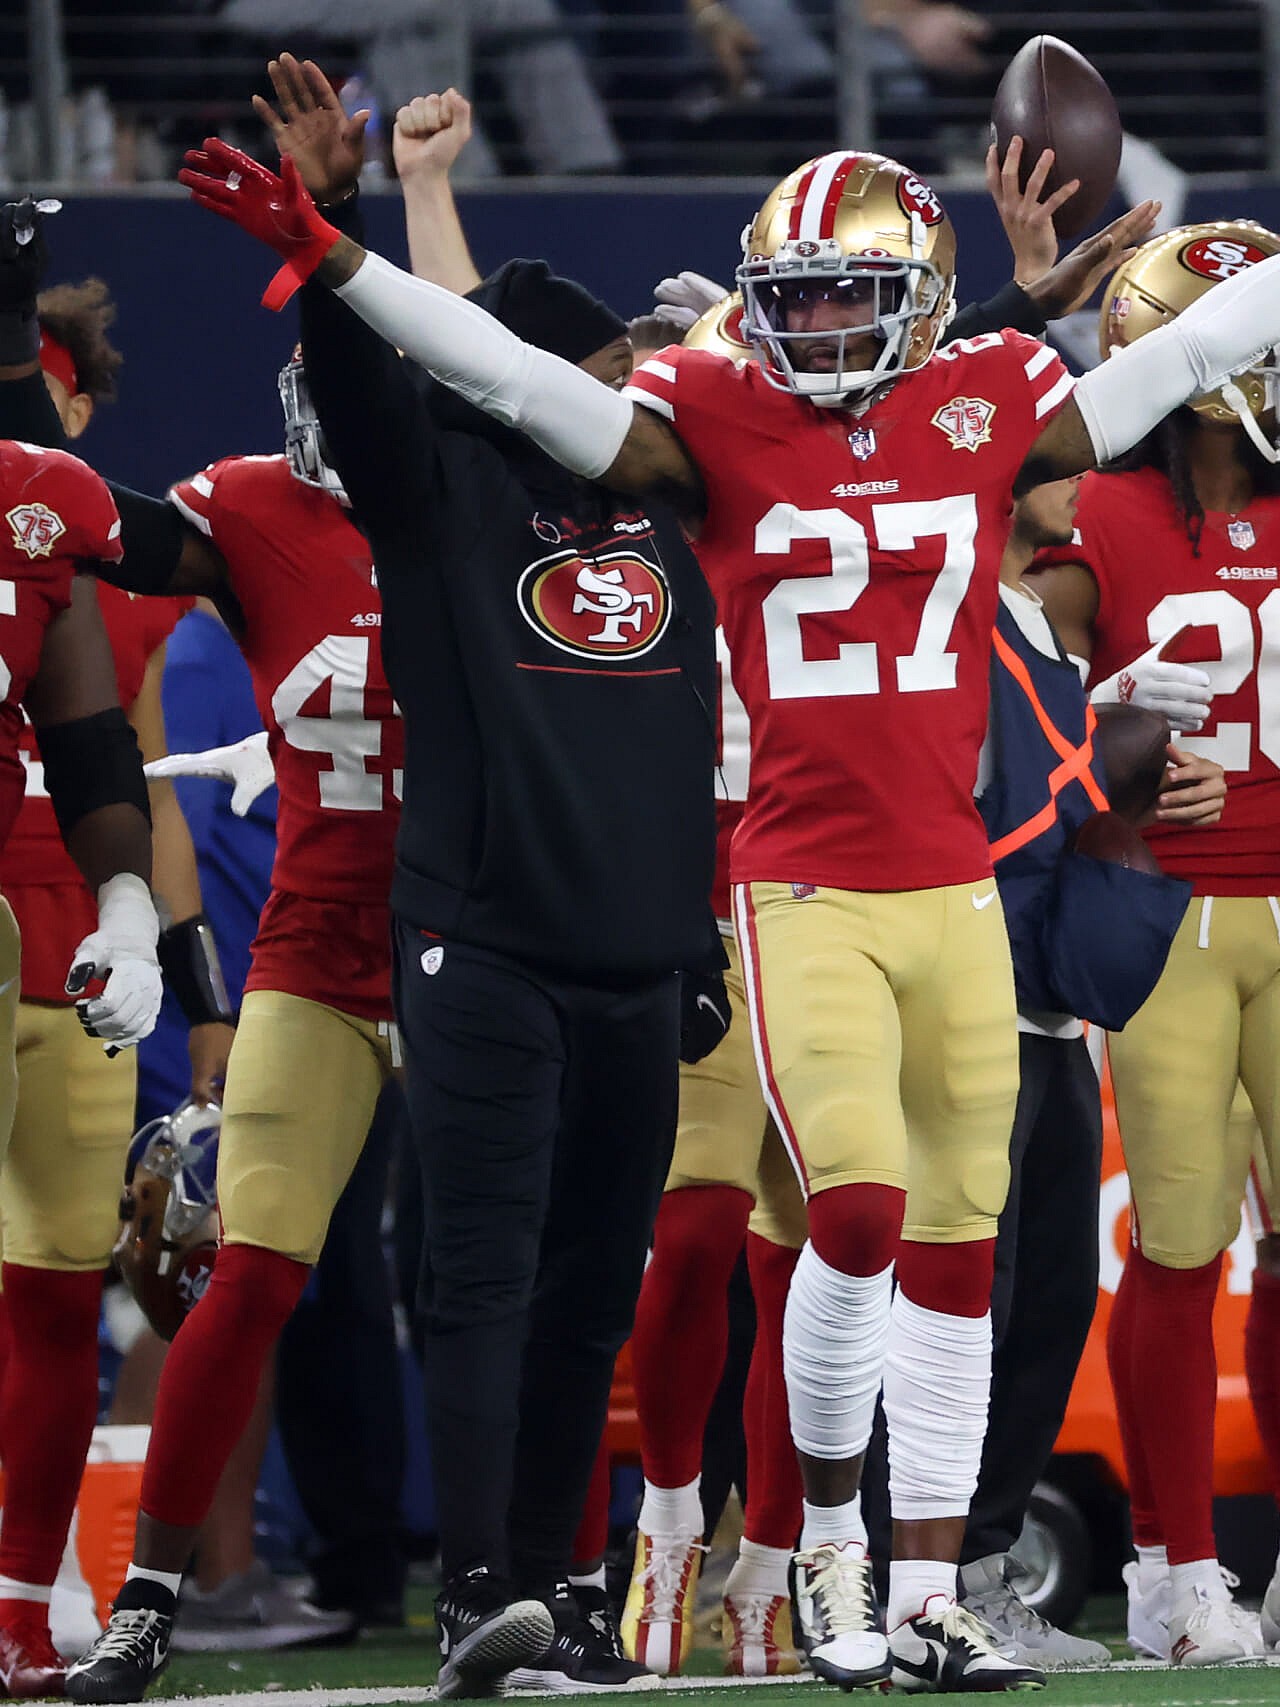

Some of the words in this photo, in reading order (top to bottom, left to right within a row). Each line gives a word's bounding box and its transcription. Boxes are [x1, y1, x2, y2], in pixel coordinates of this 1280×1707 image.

[948, 406, 983, 434] 75
[830, 479, 899, 497] 49ERS
[20, 514, 51, 543] 75
[1215, 566, 1278, 580] 49ERS
[573, 567, 653, 642] SF
[754, 494, 976, 699] 27
[271, 634, 404, 811] 4
